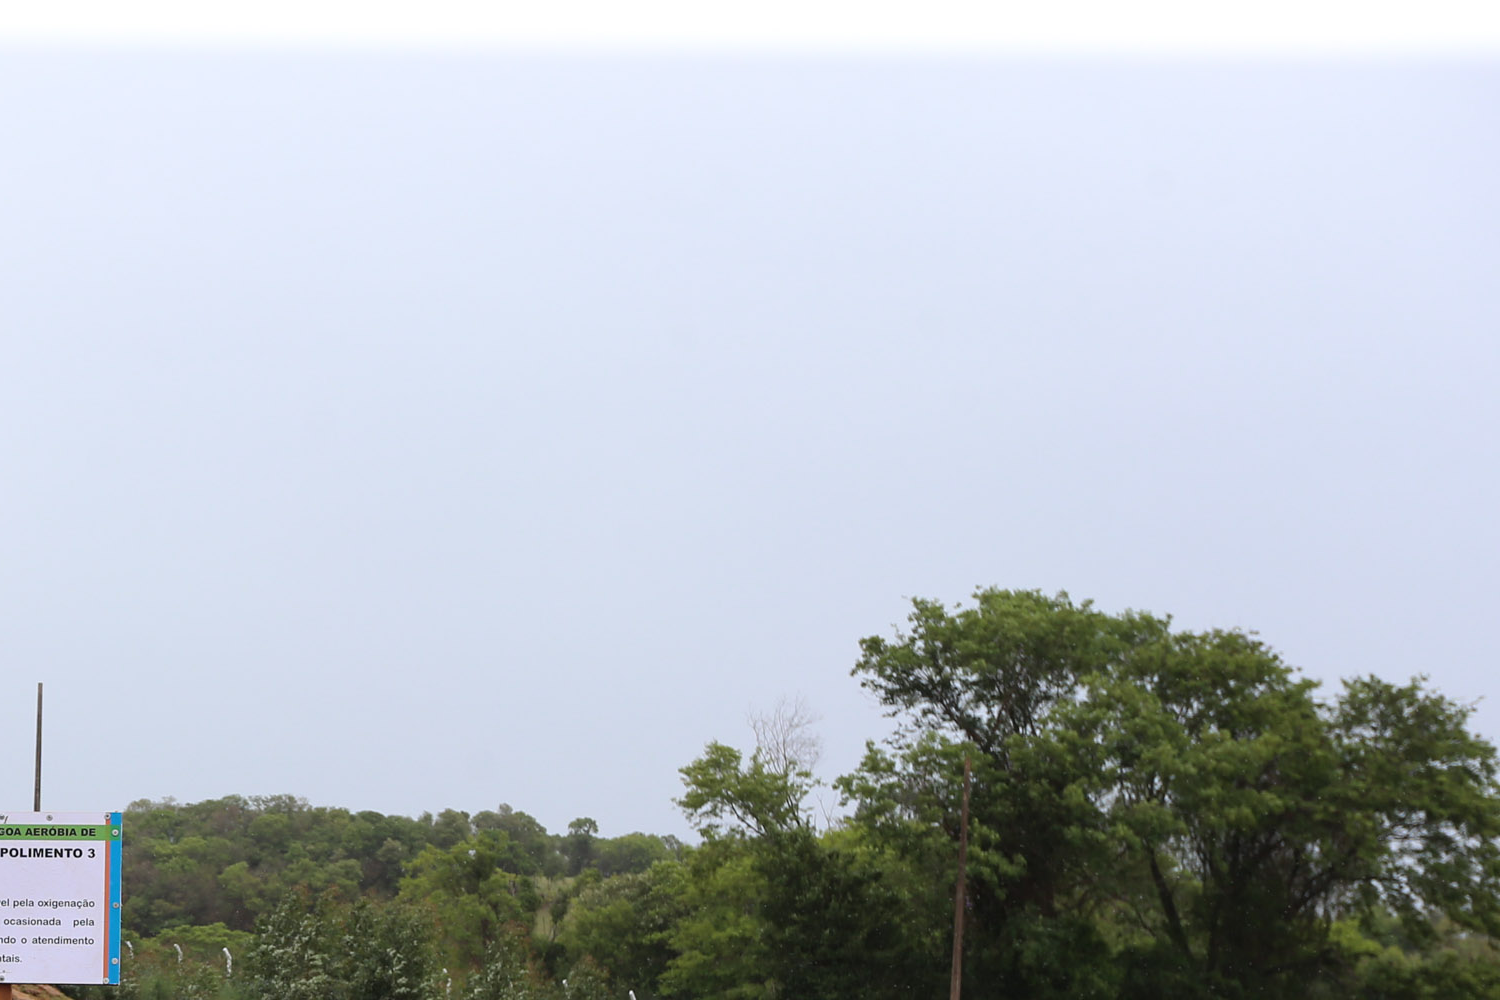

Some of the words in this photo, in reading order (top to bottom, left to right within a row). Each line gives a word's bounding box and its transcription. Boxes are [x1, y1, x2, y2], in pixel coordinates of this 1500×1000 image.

[24, 826, 76, 836] AERÓBIA
[80, 828, 96, 836] DE
[0, 848, 82, 858] POLIMENTO
[88, 848, 96, 858] 3
[12, 898, 34, 908] pela
[38, 898, 94, 910] oxigenação
[4, 918, 62, 926] ocasionada
[74, 918, 94, 928] pela
[32, 936, 94, 944] atendimento
